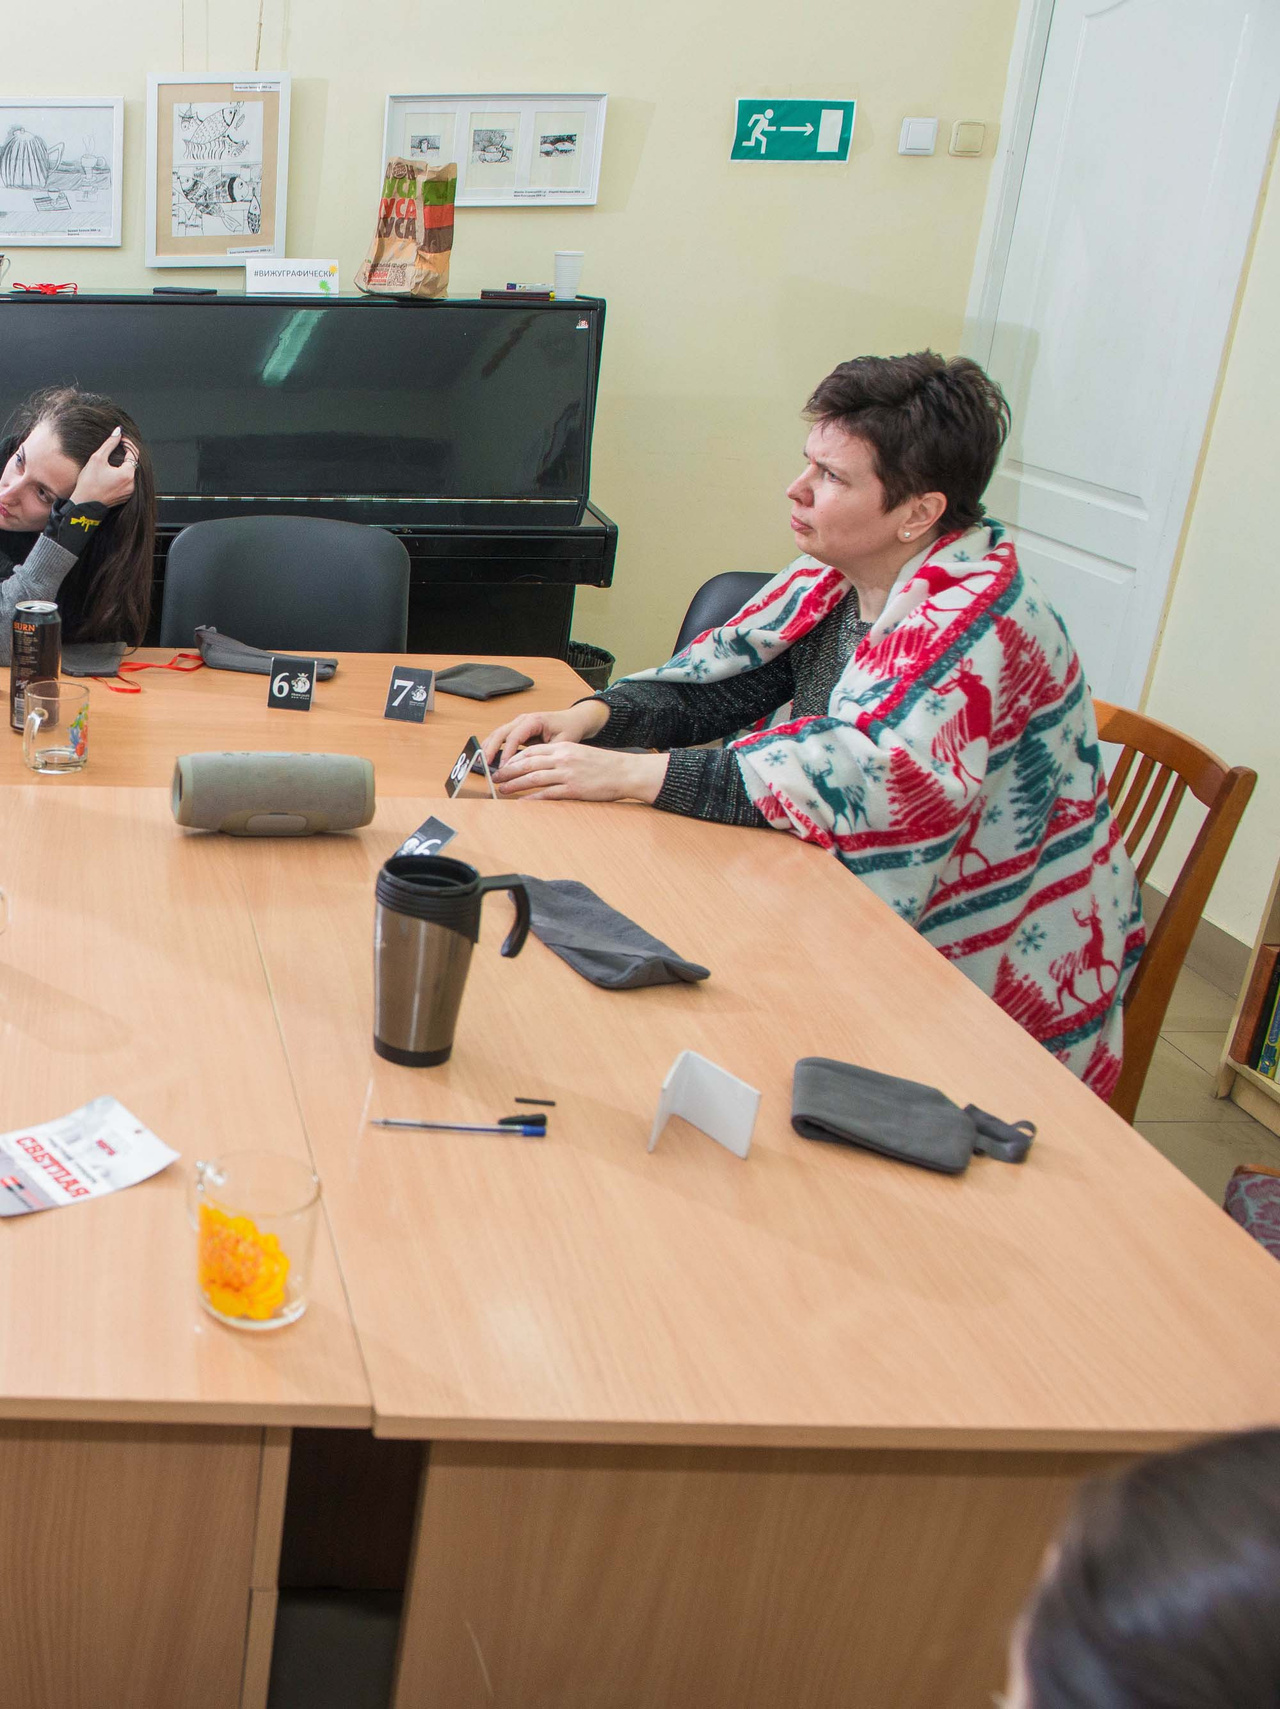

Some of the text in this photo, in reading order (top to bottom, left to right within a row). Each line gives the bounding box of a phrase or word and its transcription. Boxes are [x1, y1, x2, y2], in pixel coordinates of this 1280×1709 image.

[253, 269, 335, 278] #ВИЖУГРАФИЧЕСКИ
[13, 622, 36, 632] BURN
[272, 672, 290, 698] 6
[391, 679, 415, 707] 7
[450, 752, 467, 780] 8
[16, 1136, 90, 1198] СВЕТЛАЯ
